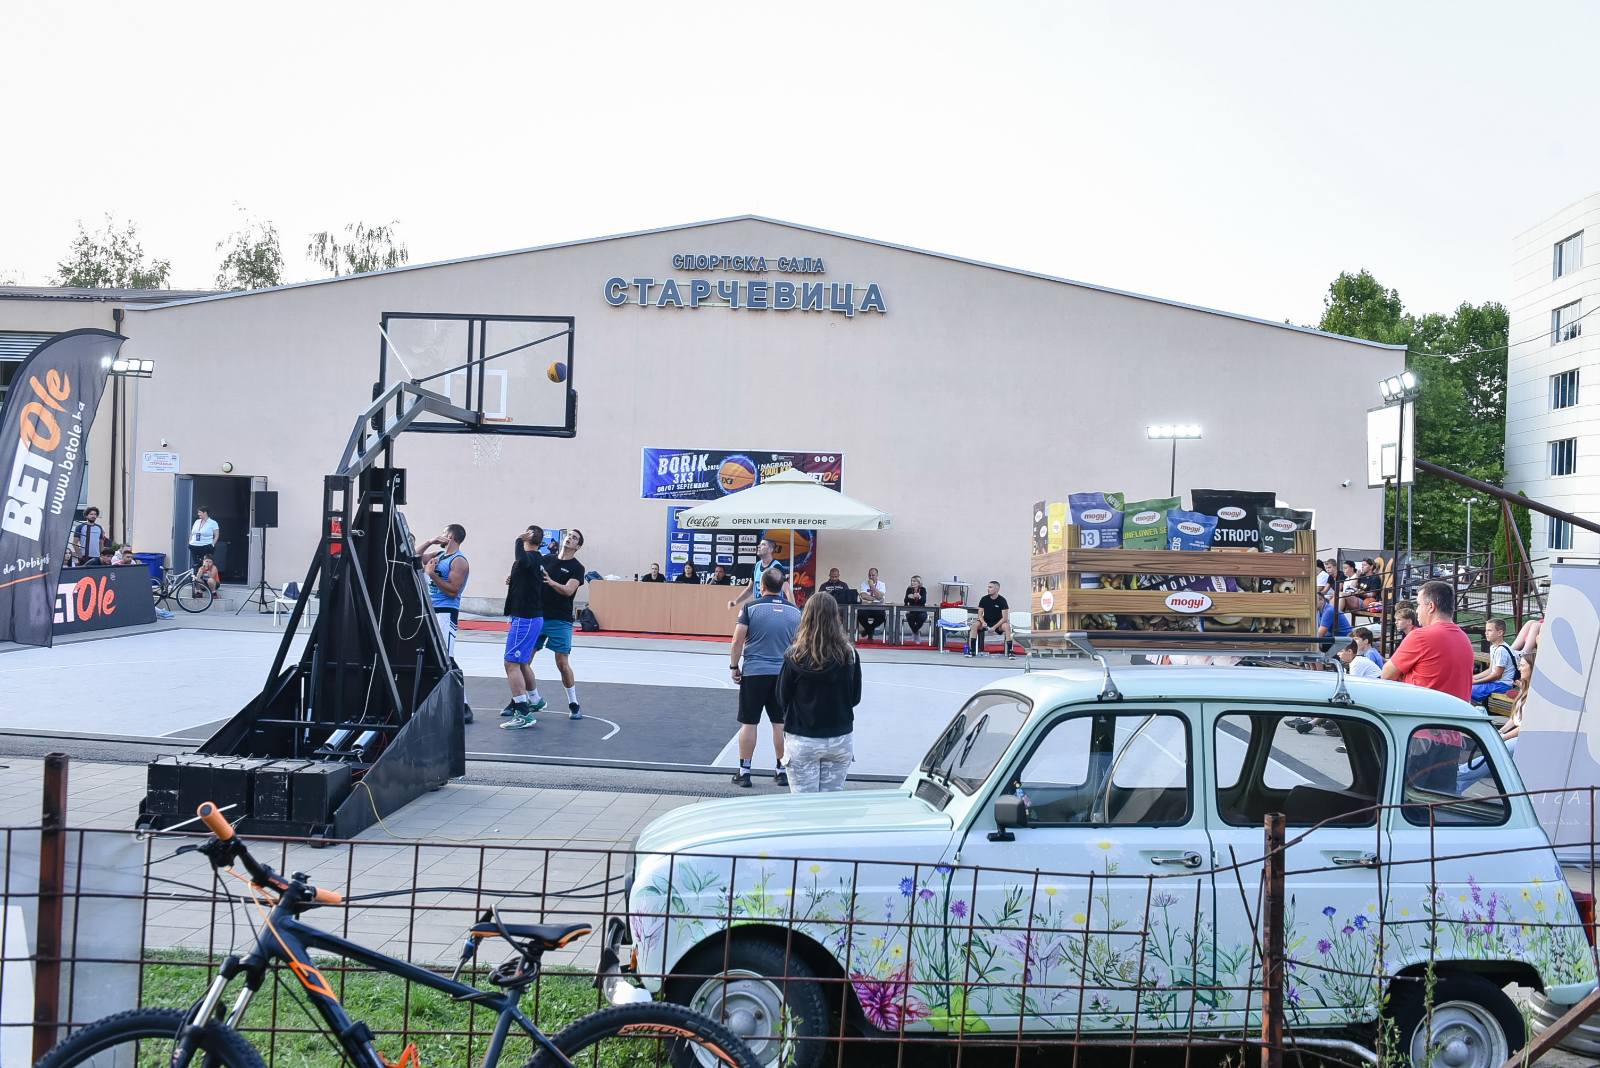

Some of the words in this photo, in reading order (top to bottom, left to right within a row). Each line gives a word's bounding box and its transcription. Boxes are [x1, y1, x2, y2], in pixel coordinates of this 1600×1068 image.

[671, 253, 768, 272] СПОРТСКА
[777, 256, 825, 273] САЛА
[603, 276, 888, 317] СТАРЧЕВИЦА
[1, 368, 71, 541] BETOle
[657, 453, 709, 476] BORIK
[673, 472, 694, 484] 3X3
[1084, 511, 1108, 521] mogyi
[1220, 509, 1242, 518] mogyi
[1213, 528, 1259, 542] STROPO
[1170, 597, 1205, 608] mogyi
